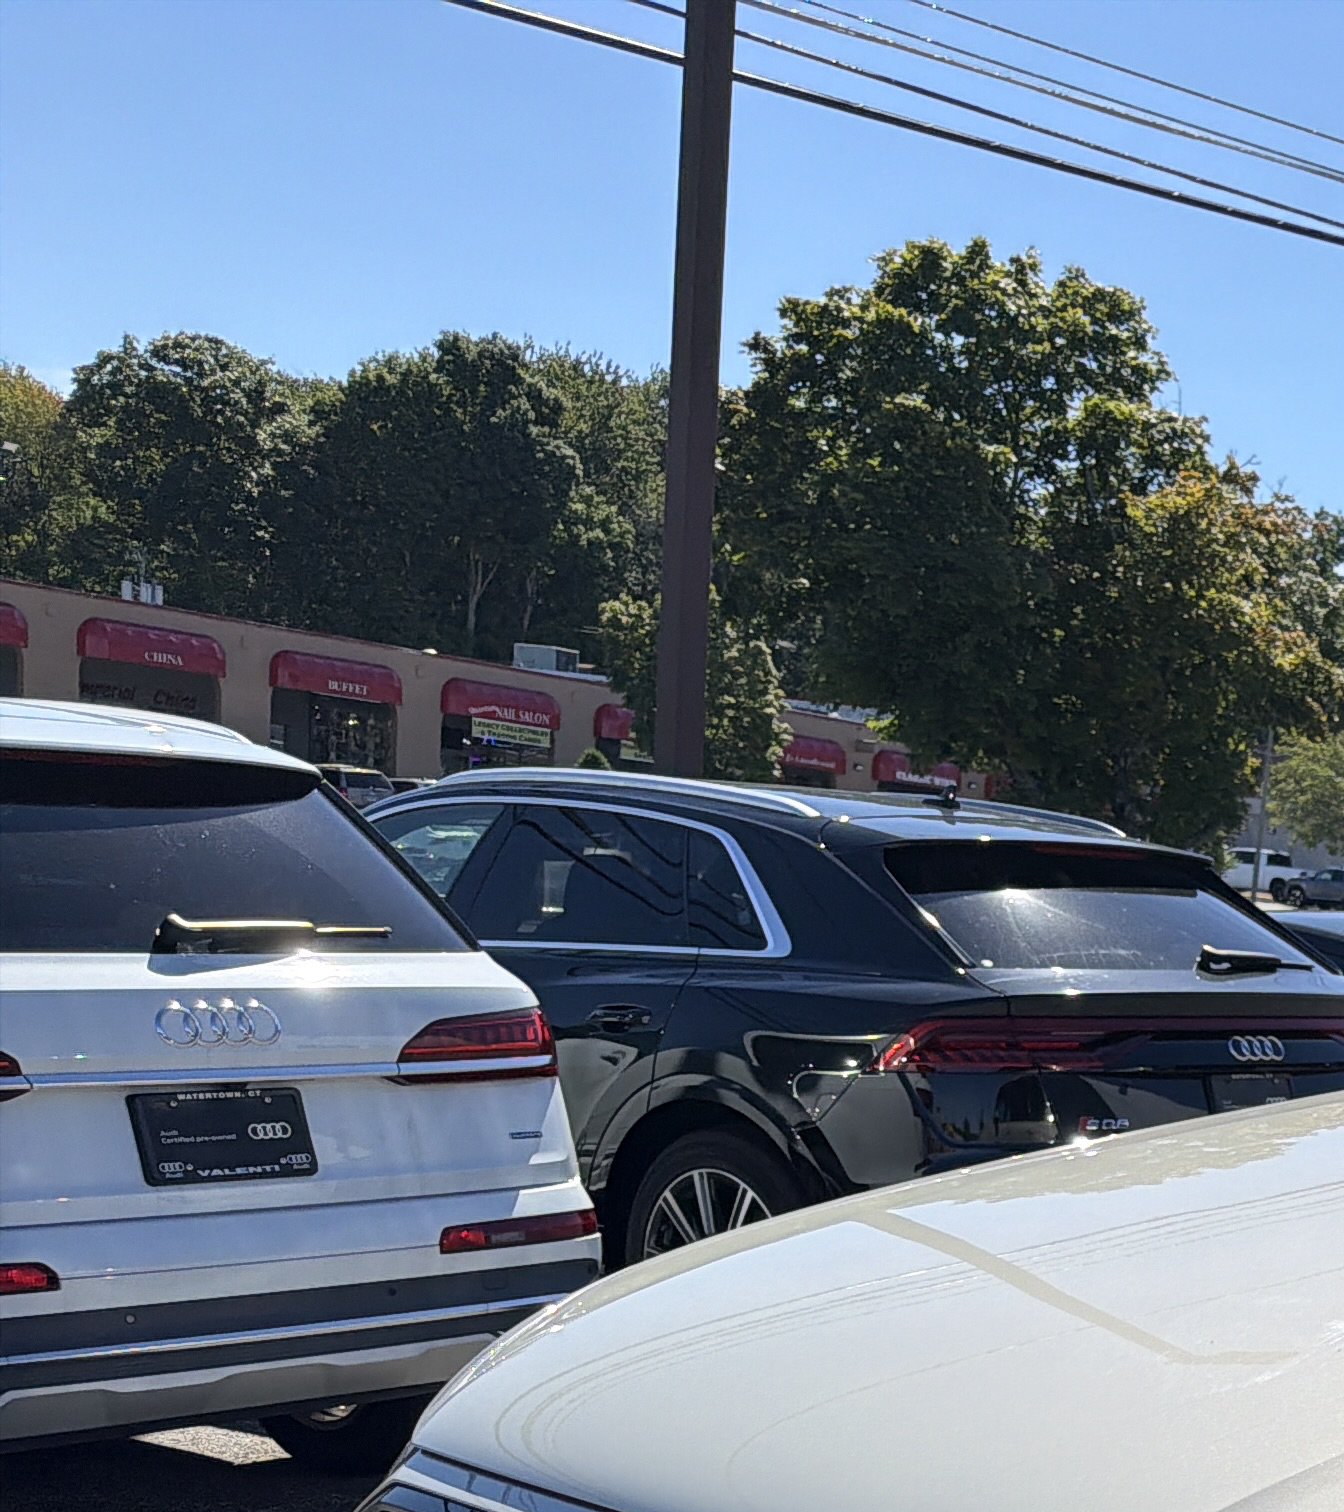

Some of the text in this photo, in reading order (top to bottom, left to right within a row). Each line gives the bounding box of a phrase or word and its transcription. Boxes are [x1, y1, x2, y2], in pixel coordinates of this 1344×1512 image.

[144, 651, 184, 666] CHINA
[328, 679, 368, 696] BUFFET
[496, 707, 518, 721] NAIL
[519, 710, 551, 725] SALON
[248, 1089, 262, 1097] CT
[160, 1135, 195, 1145] Certified
[197, 1164, 280, 1177] VALENTI
